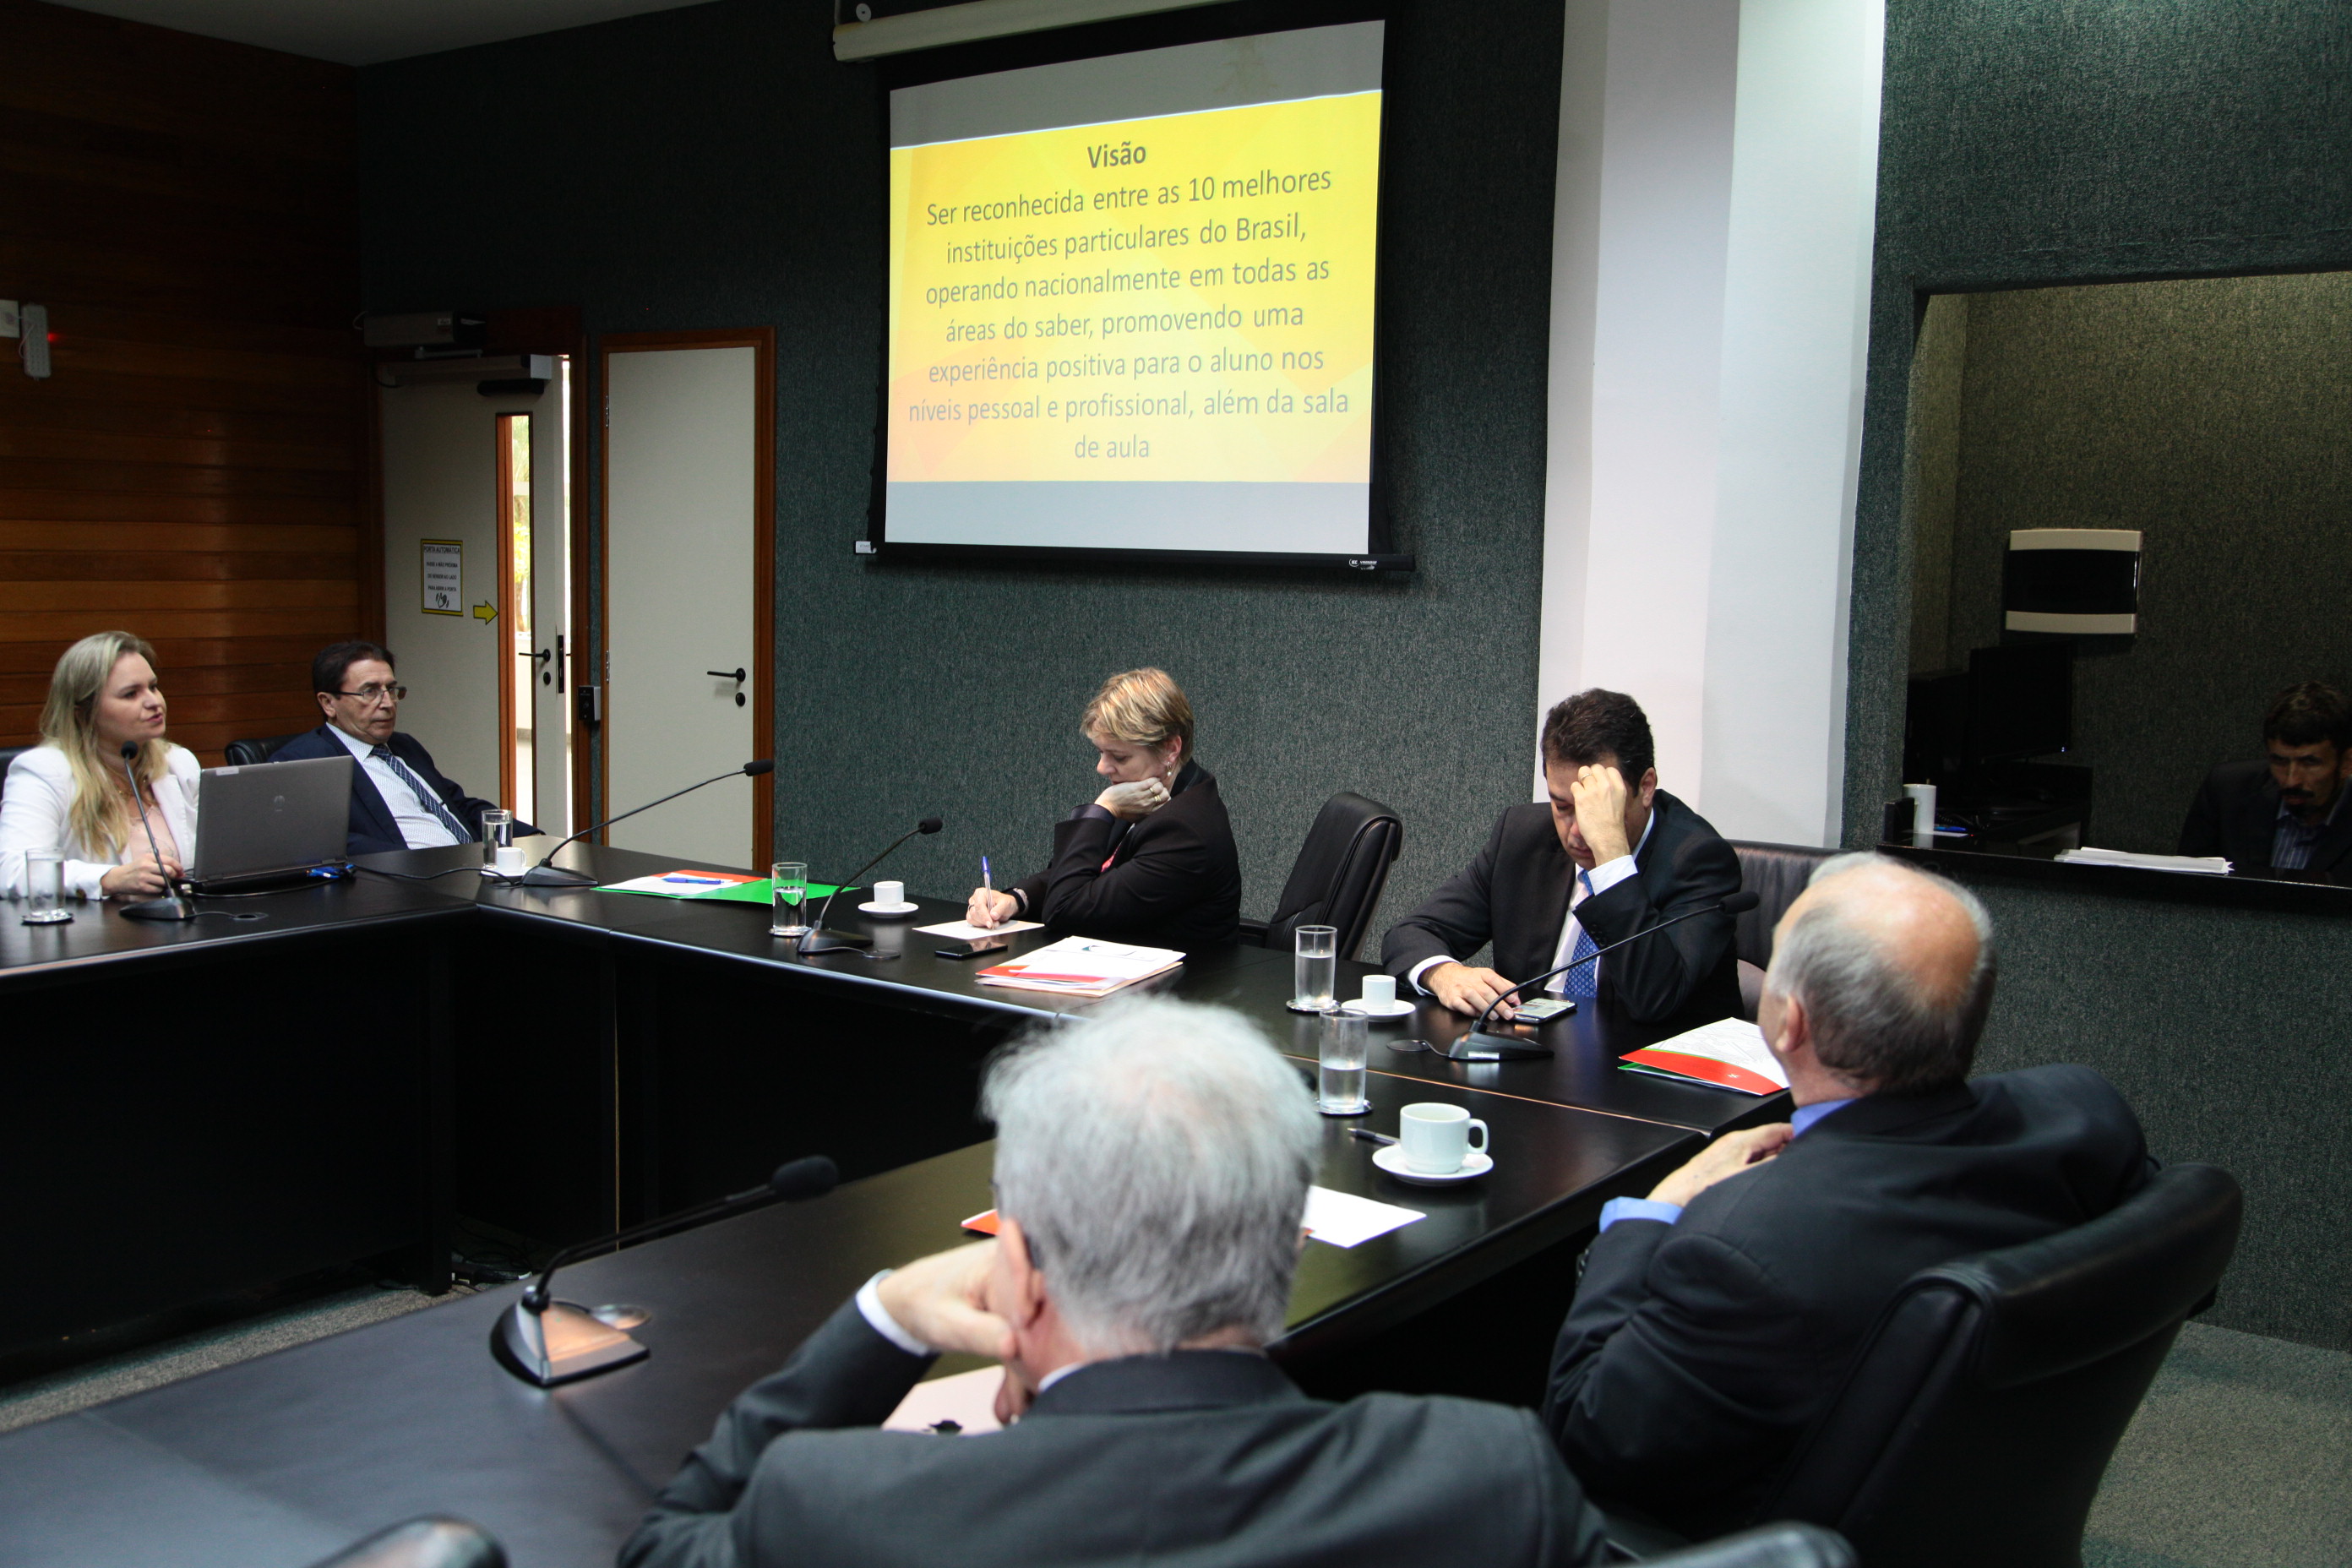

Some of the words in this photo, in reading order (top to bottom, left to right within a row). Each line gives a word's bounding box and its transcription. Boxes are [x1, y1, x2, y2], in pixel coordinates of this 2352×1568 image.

[1086, 140, 1147, 169] Visão
[927, 203, 958, 226] Ser
[963, 189, 1085, 221] reconhecida
[1093, 186, 1149, 210] entre
[1157, 184, 1180, 204] as
[1189, 176, 1216, 202] 10
[1222, 168, 1332, 199] melhores
[947, 233, 1059, 264] instituições
[1064, 225, 1190, 260] particulares
[1200, 218, 1228, 244] do
[1236, 211, 1306, 242] Brasil,
[926, 275, 1019, 308] operando
[1025, 267, 1181, 297] nacionalmente
[1190, 267, 1224, 287] em
[1232, 256, 1298, 285] todas
[1306, 259, 1330, 280] as
[945, 318, 997, 342] áreas
[1004, 315, 1028, 340] do
[1034, 313, 1093, 340] saber,
[1102, 304, 1244, 338] promovendo
[1254, 307, 1304, 328] uma
[928, 356, 1039, 387] experiência
[1046, 352, 1126, 384] positiva
[1133, 355, 1180, 381] para
[1188, 354, 1203, 373] o
[1210, 348, 1274, 373] aluno
[1282, 351, 1324, 370] nos
[909, 398, 962, 422] níveis
[968, 395, 1041, 426] pessoal
[1047, 400, 1059, 418] e
[1065, 389, 1195, 423] profissional,
[1203, 388, 1260, 416] além
[1266, 387, 1295, 414] da
[1303, 386, 1350, 414] sala
[1075, 434, 1101, 459] de
[1106, 434, 1151, 459] aula
